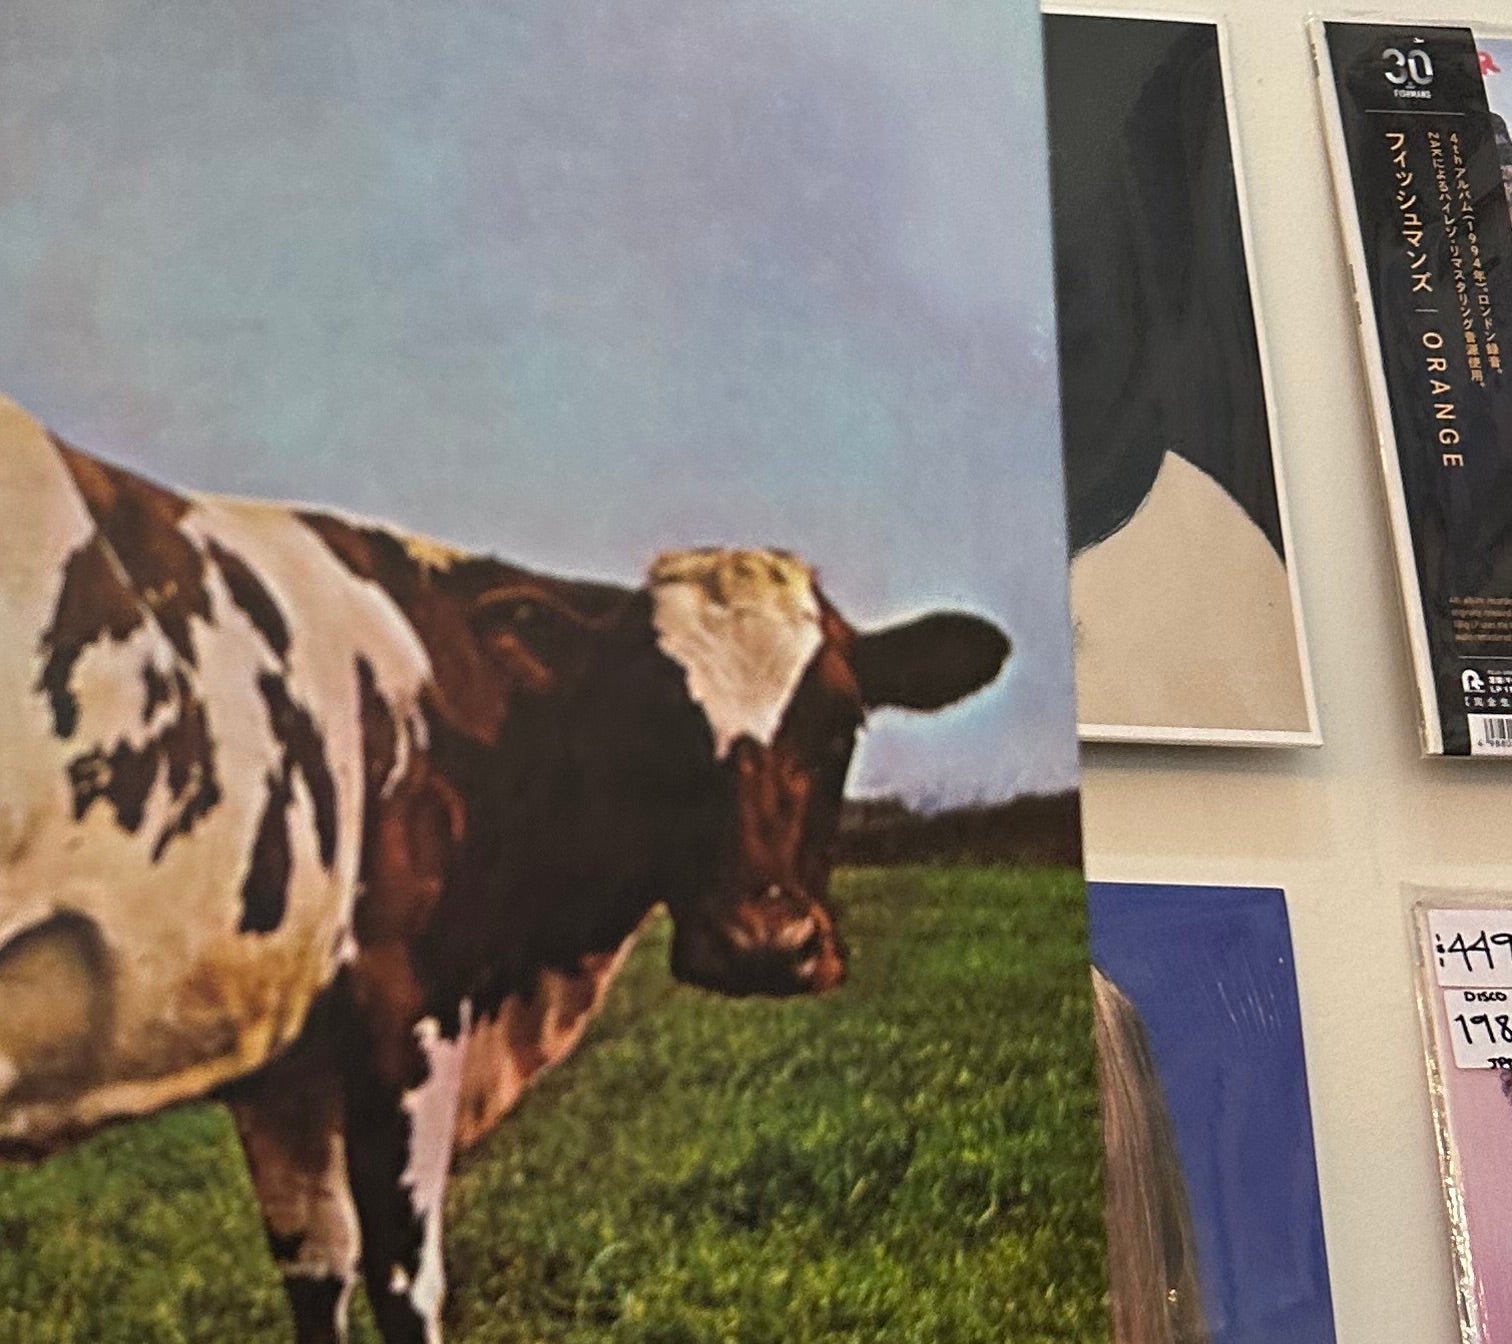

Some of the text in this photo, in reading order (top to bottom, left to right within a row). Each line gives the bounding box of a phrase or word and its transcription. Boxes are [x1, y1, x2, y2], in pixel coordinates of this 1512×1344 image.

[1382, 48, 1434, 86] 30
[1385, 132, 1433, 293] フィッシュマンズ
[1422, 331, 1465, 467] ORANGE
[1463, 991, 1508, 1002] DISCO
